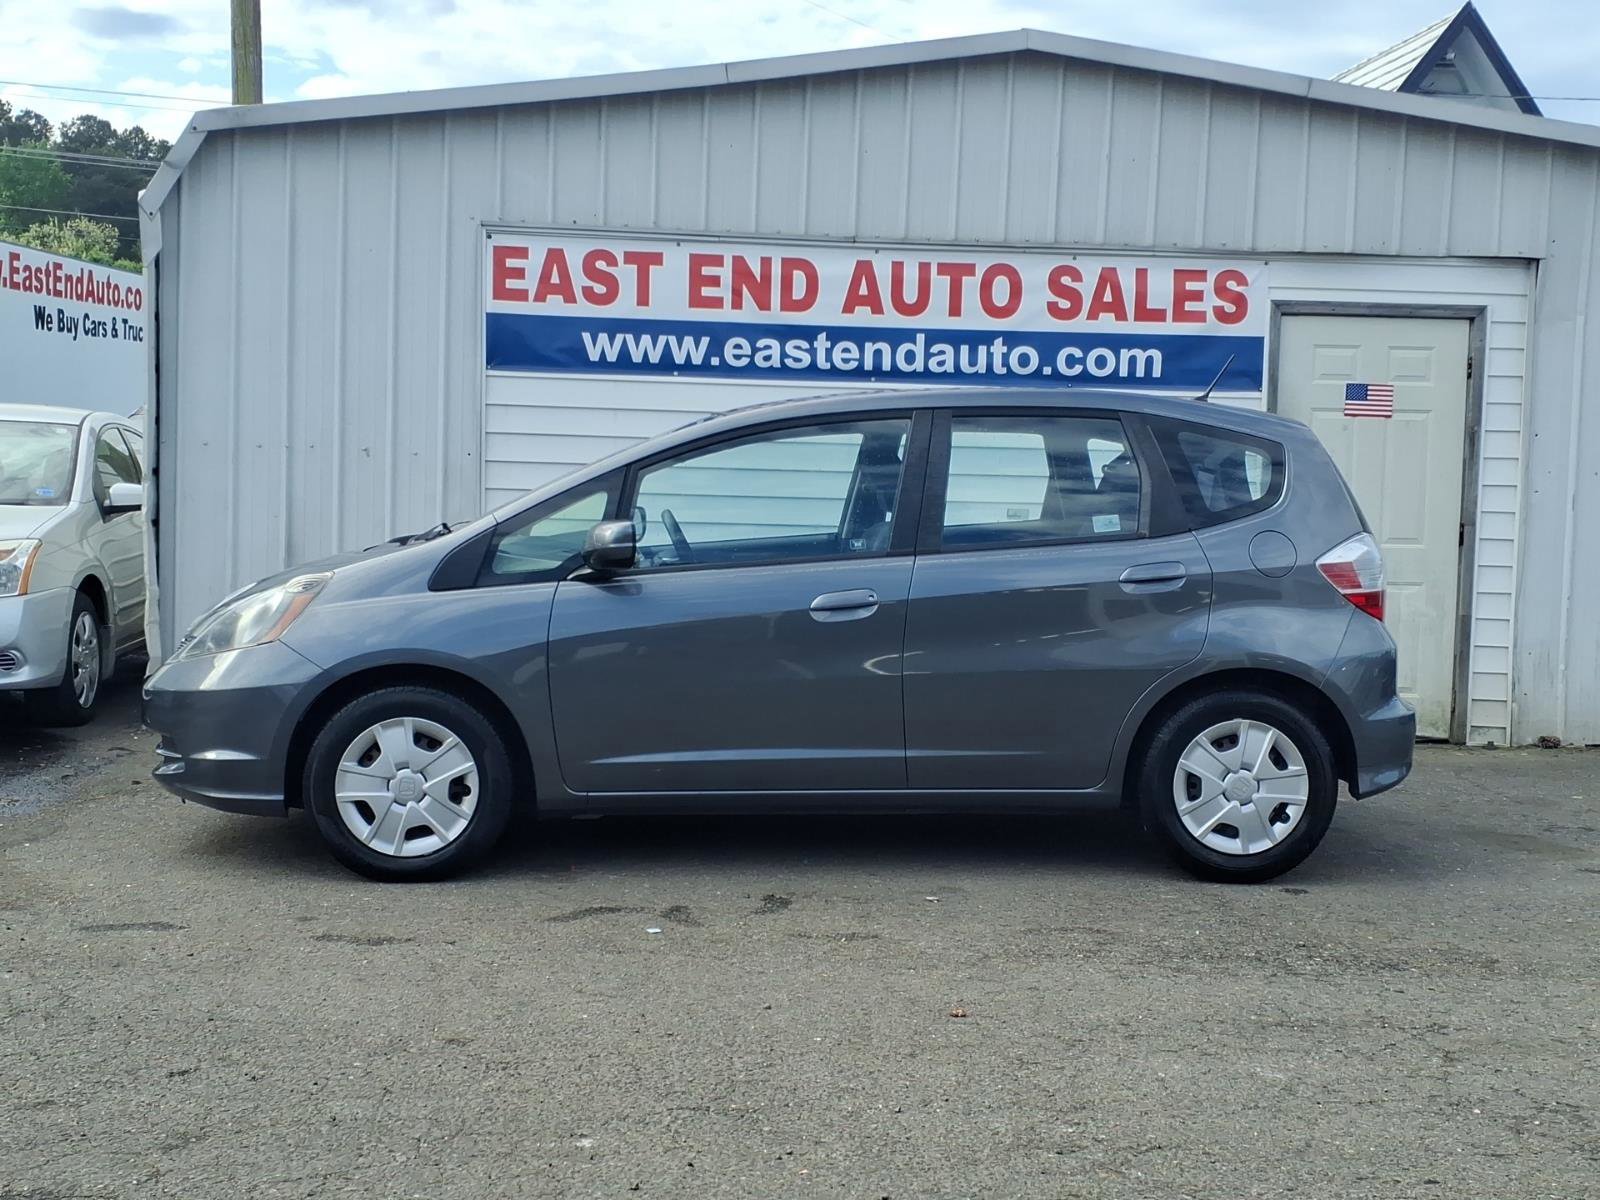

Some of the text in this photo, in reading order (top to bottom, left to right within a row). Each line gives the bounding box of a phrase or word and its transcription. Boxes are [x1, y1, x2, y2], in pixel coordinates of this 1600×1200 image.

[0, 251, 143, 311] .EastEndAuto.co
[492, 245, 1249, 325] EAST END AUTO SALES
[33, 304, 54, 332] We
[57, 308, 79, 341] Buy
[83, 313, 108, 338] Cars
[111, 316, 119, 339] &
[581, 332, 1163, 378] www.eastendauto.com
